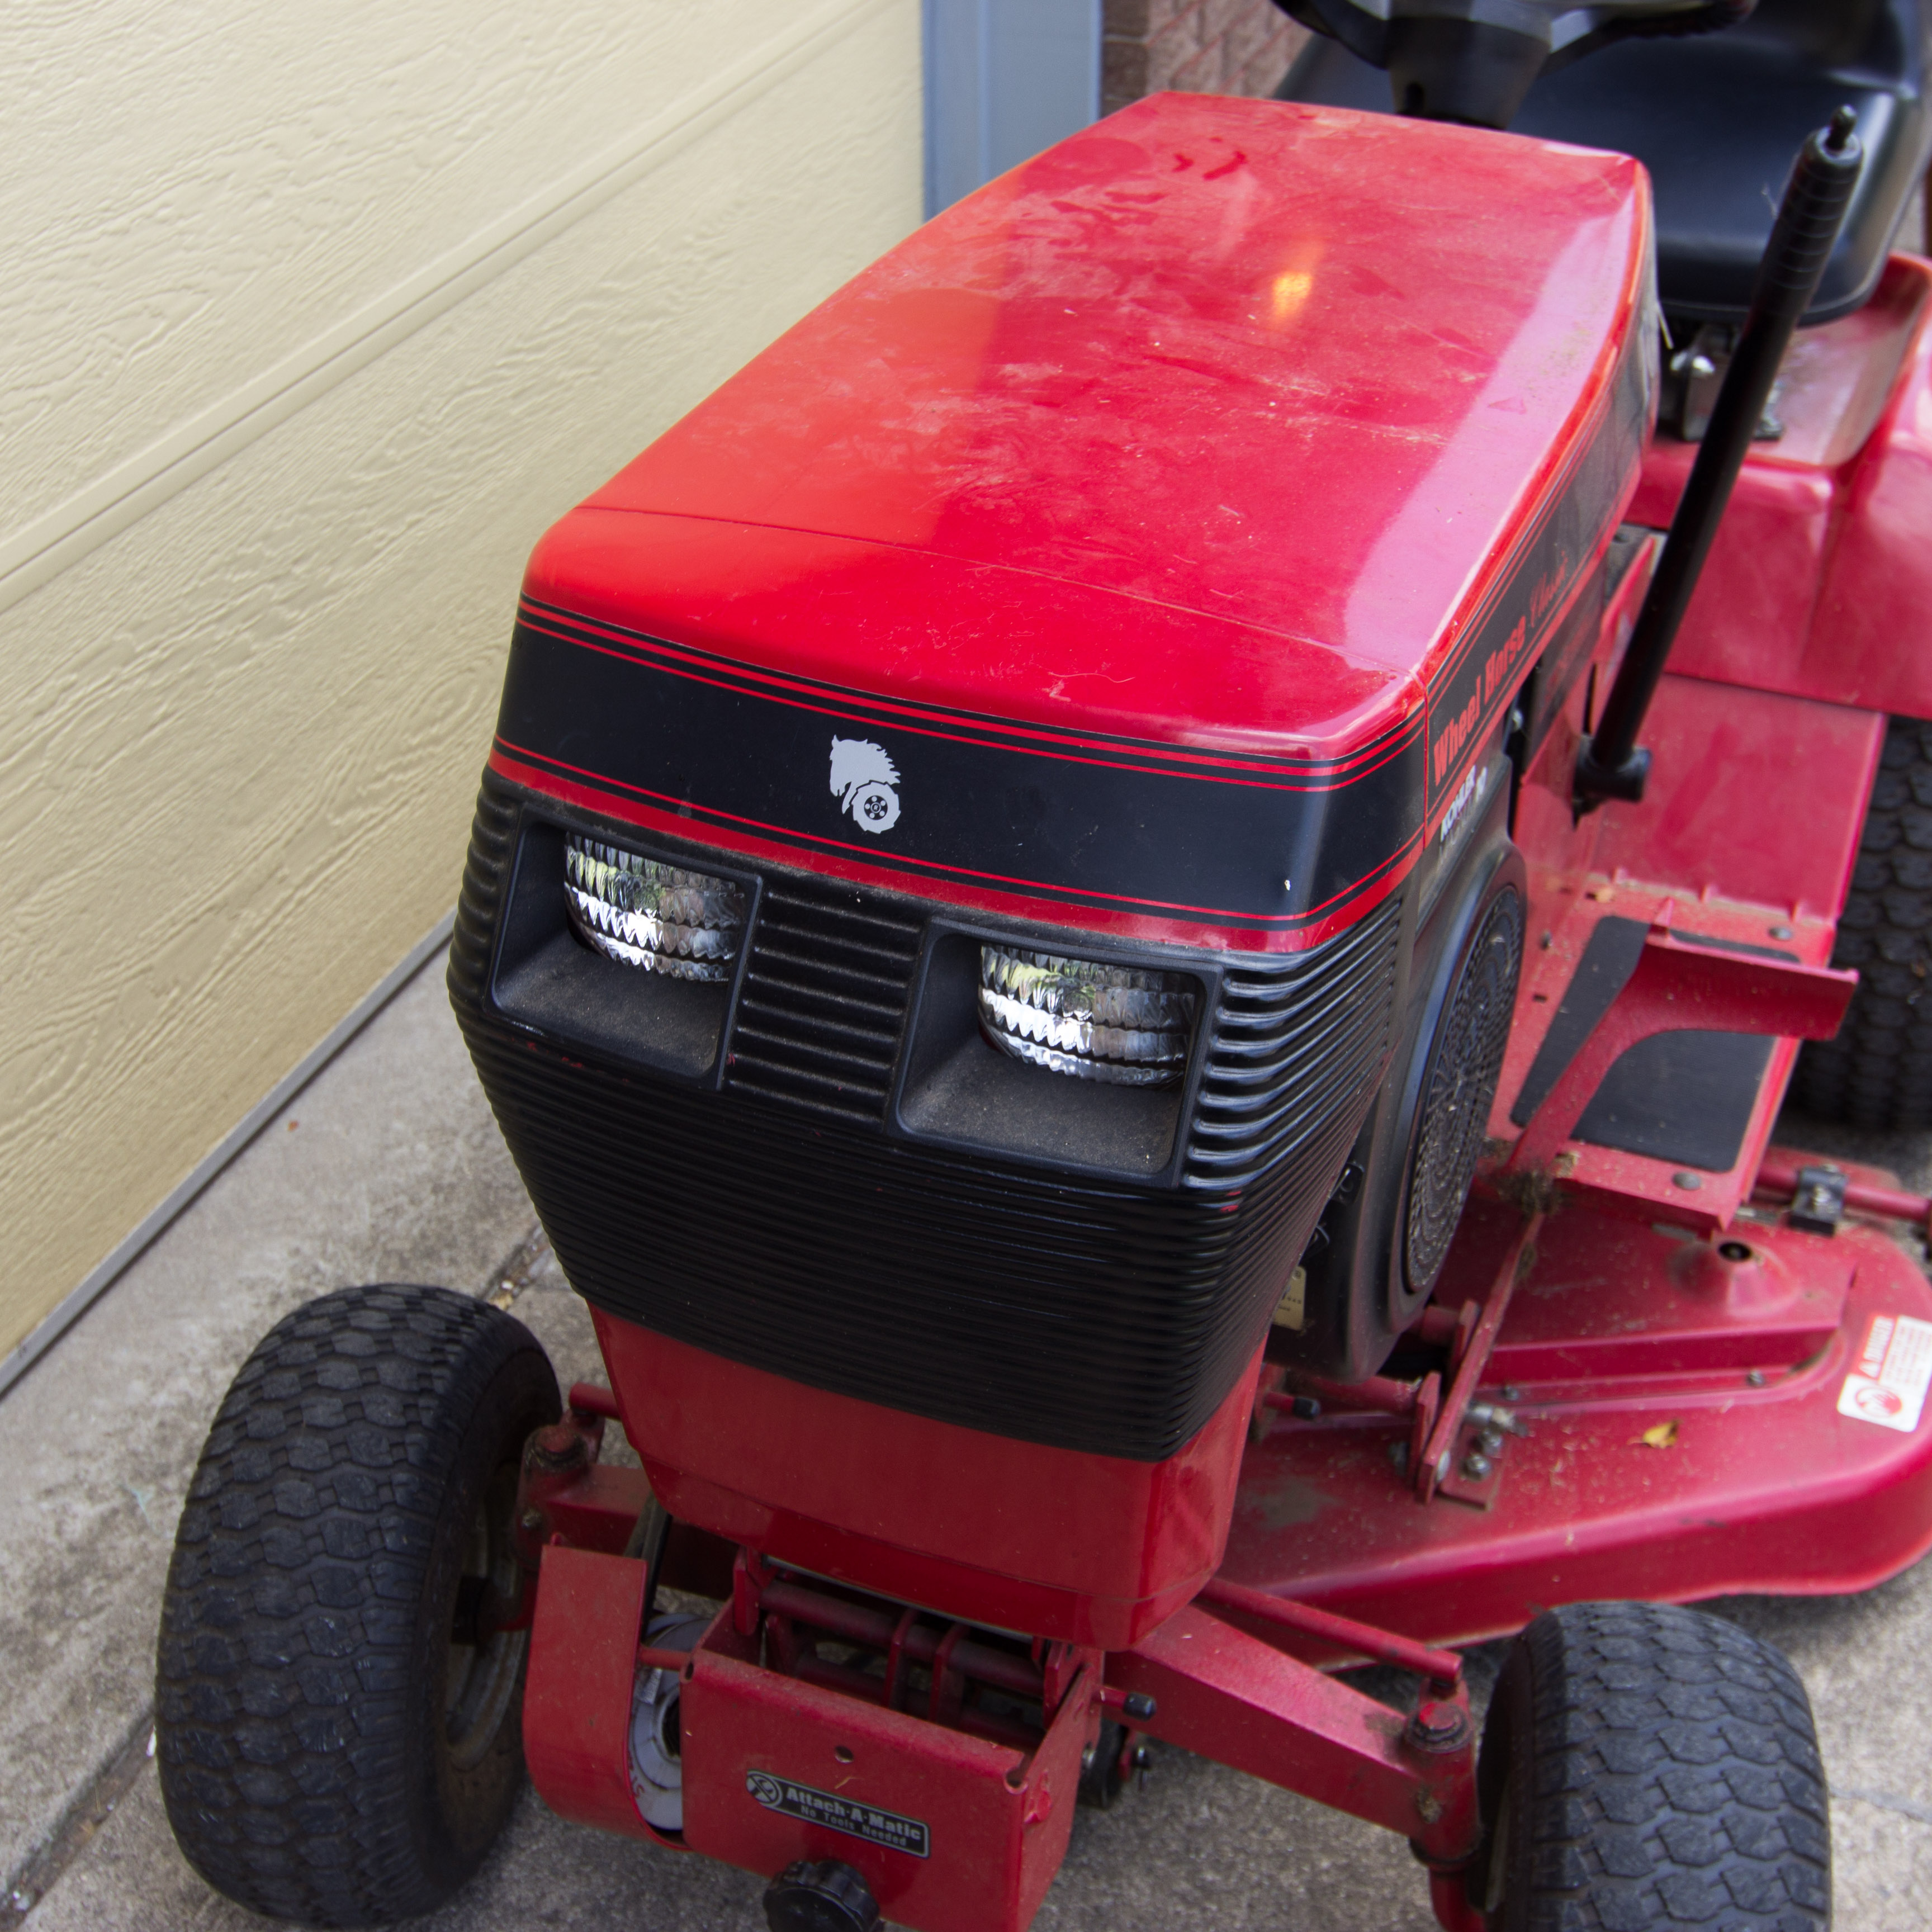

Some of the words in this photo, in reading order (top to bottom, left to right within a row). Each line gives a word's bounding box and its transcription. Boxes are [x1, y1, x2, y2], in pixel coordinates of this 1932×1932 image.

[1434, 675, 1481, 787] Wheel
[1484, 615, 1526, 705] Horse
[801, 1805, 817, 1818] No
[825, 1812, 855, 1831] Tools
[862, 1825, 907, 1847] Needed
